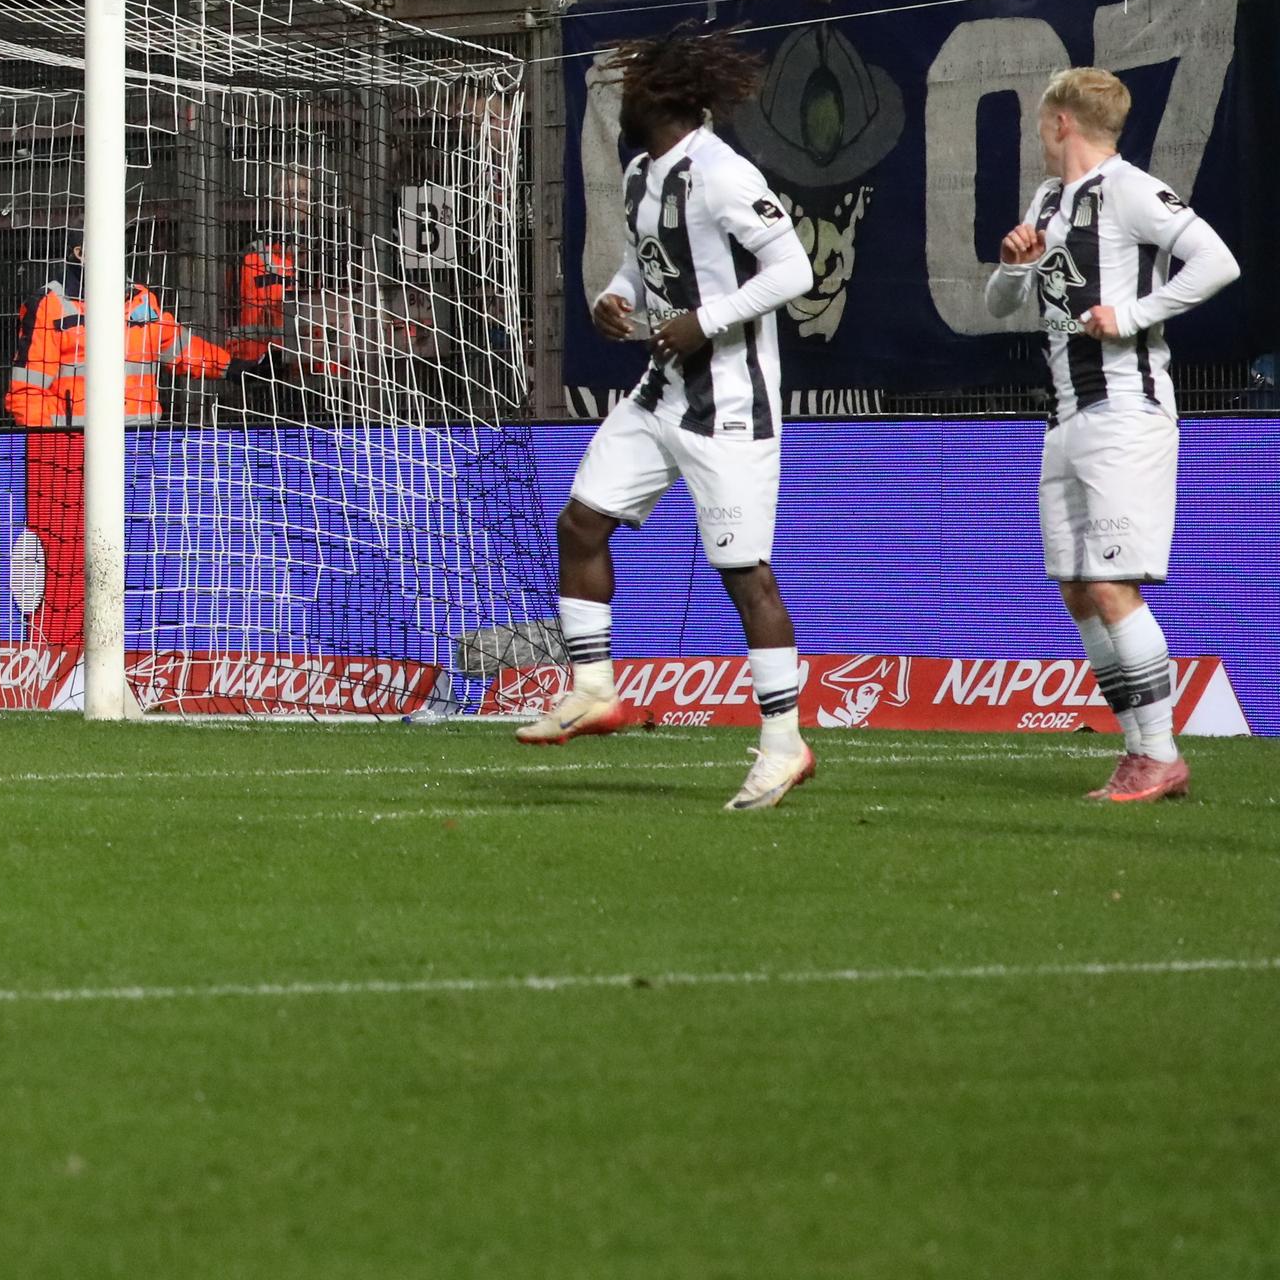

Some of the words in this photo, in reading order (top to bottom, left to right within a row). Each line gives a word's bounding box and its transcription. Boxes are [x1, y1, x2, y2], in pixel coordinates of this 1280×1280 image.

[417, 203, 441, 255] B
[205, 655, 425, 715] NAPOLEON
[659, 710, 715, 727] SCORE
[1017, 711, 1079, 729] SCORE
